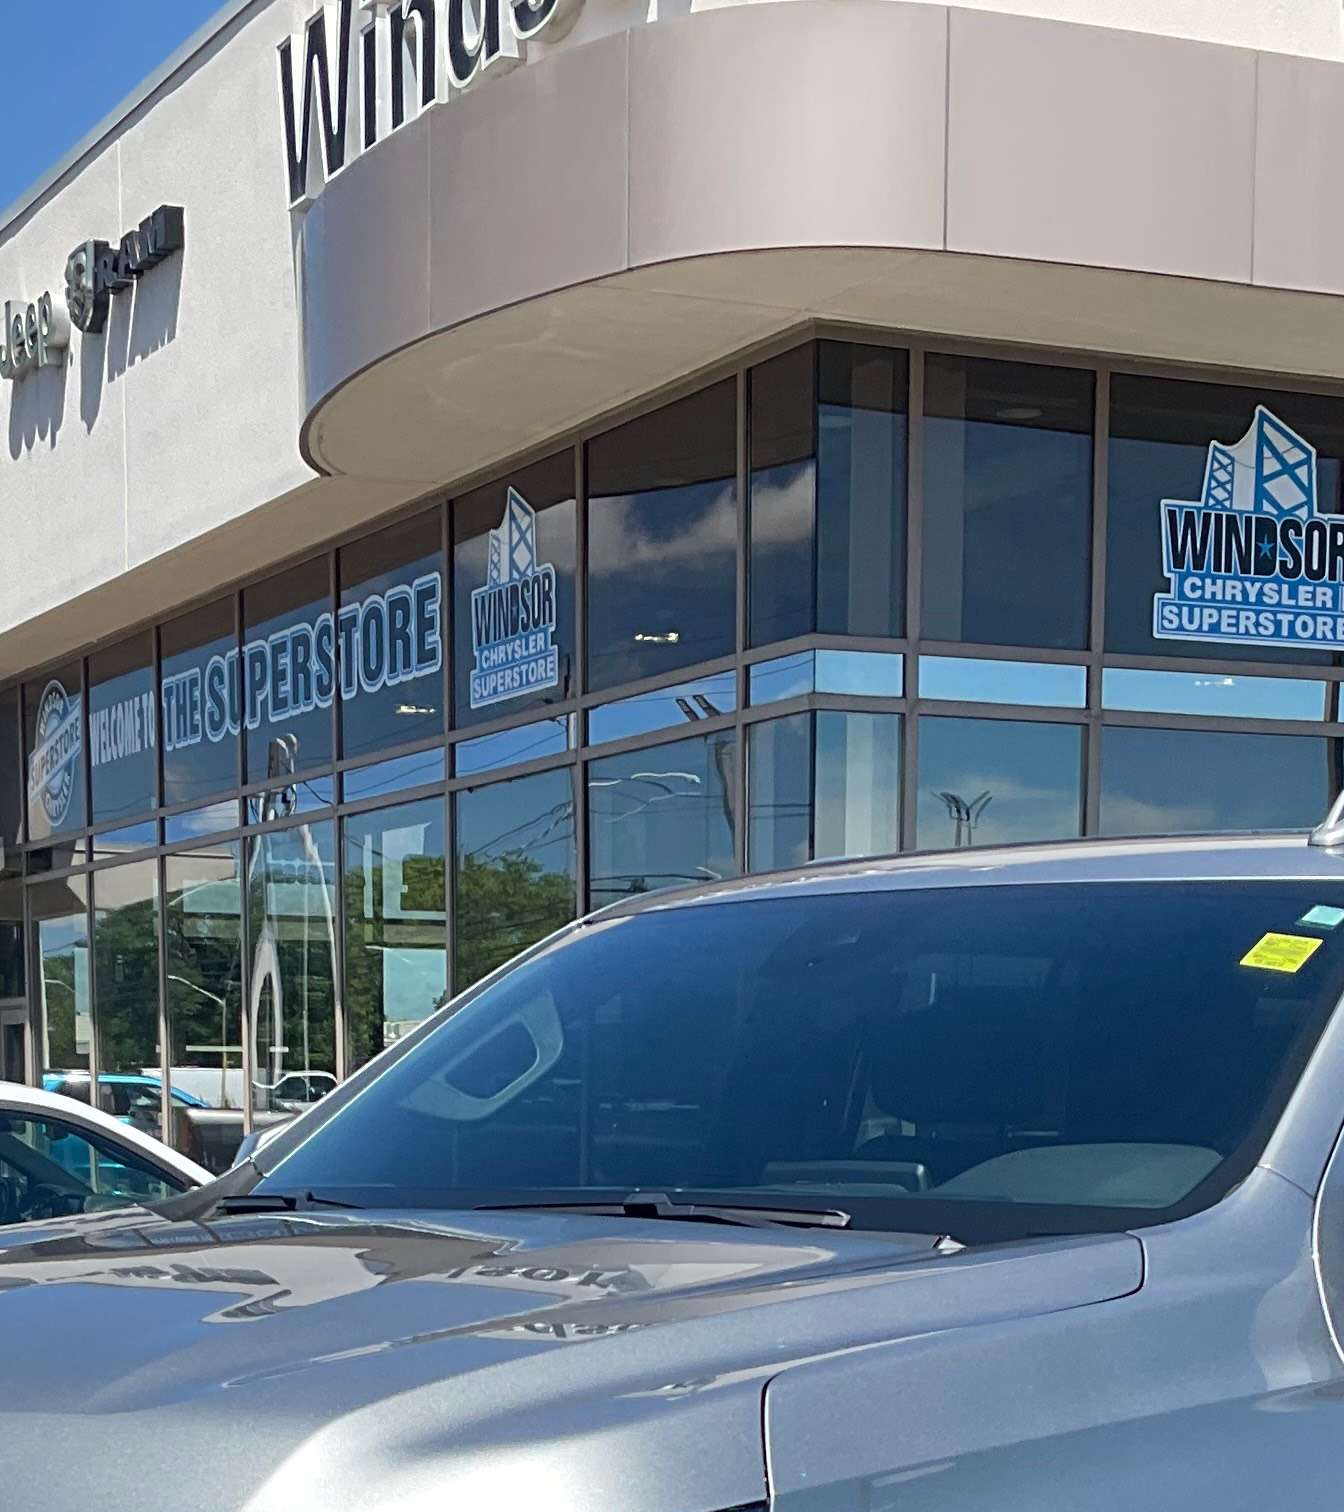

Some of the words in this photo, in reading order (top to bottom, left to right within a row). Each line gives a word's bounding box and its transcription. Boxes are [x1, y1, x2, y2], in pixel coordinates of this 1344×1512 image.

[474, 573, 554, 647] WINDSOR
[1183, 576, 1333, 609] CHRYSLER
[89, 696, 142, 767] WELCOME
[141, 690, 155, 750] TO
[163, 671, 201, 750] THE
[207, 576, 440, 741] SUPERSTORE
[472, 655, 555, 699] SUPERSTORE
[481, 632, 545, 670] CHRYSLER
[31, 715, 81, 791] SUPERSTORE
